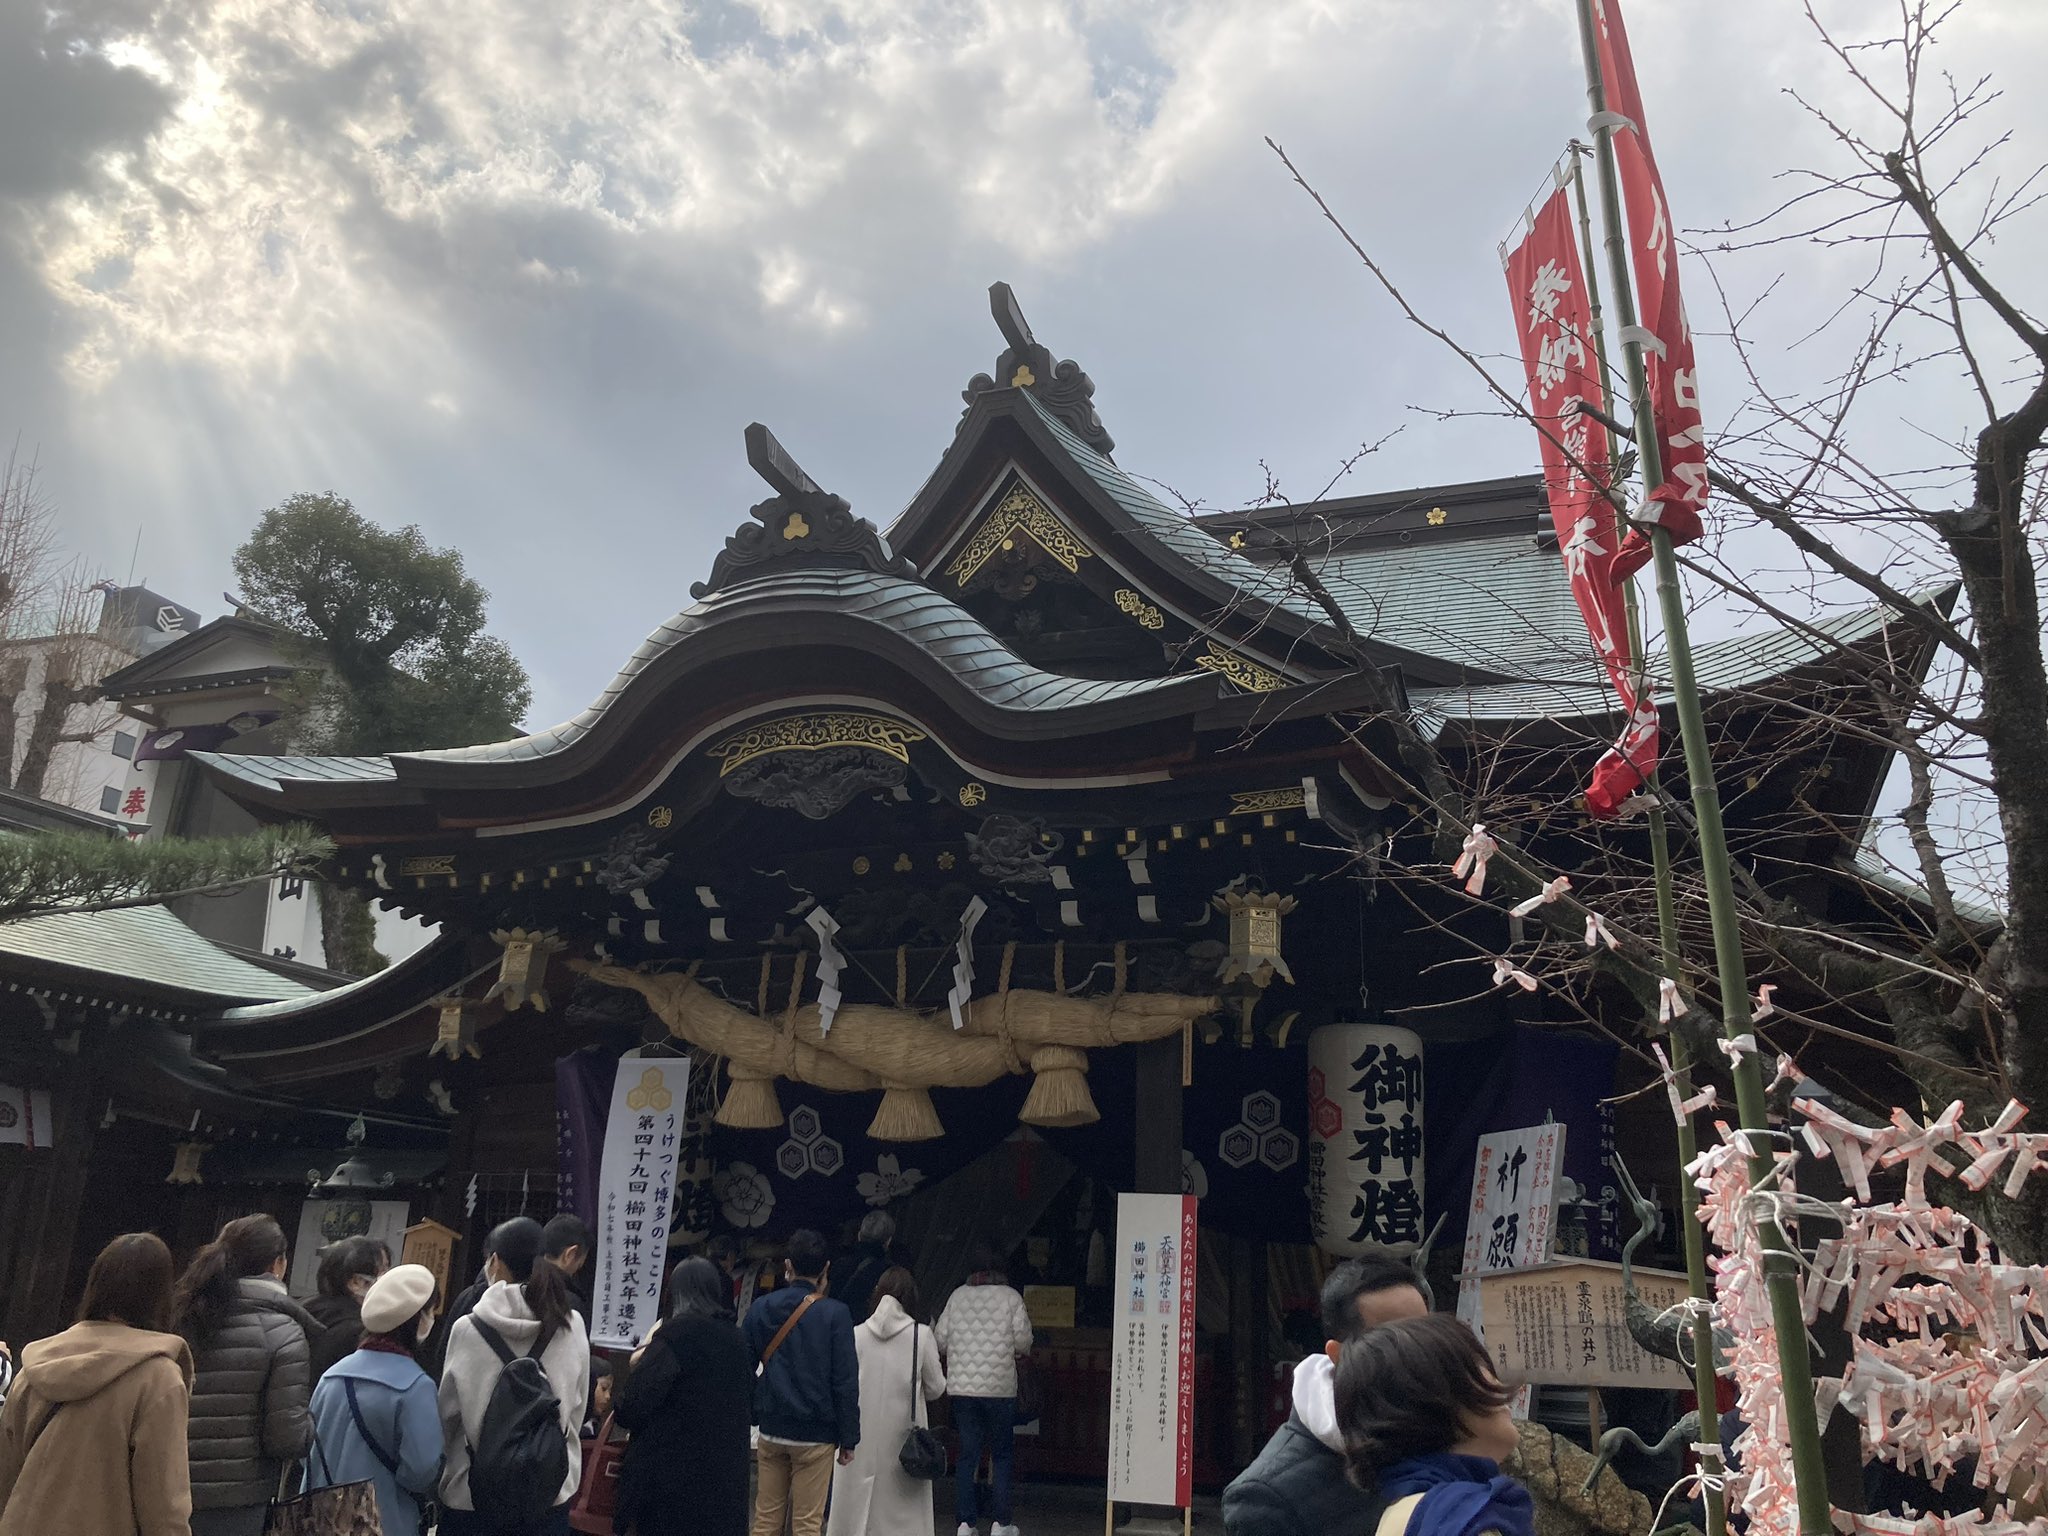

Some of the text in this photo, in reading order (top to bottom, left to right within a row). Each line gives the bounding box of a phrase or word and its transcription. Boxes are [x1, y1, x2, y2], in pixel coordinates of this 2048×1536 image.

[1528, 257, 1586, 400] 奉納
[645, 1113, 676, 1298] うけつぐ博多のこころ
[1347, 1043, 1423, 1245] 御神燈
[1486, 1144, 1528, 1269] 祈願
[1178, 1213, 1194, 1478] あなたのお部屋にお神様をお迎えしましょう
